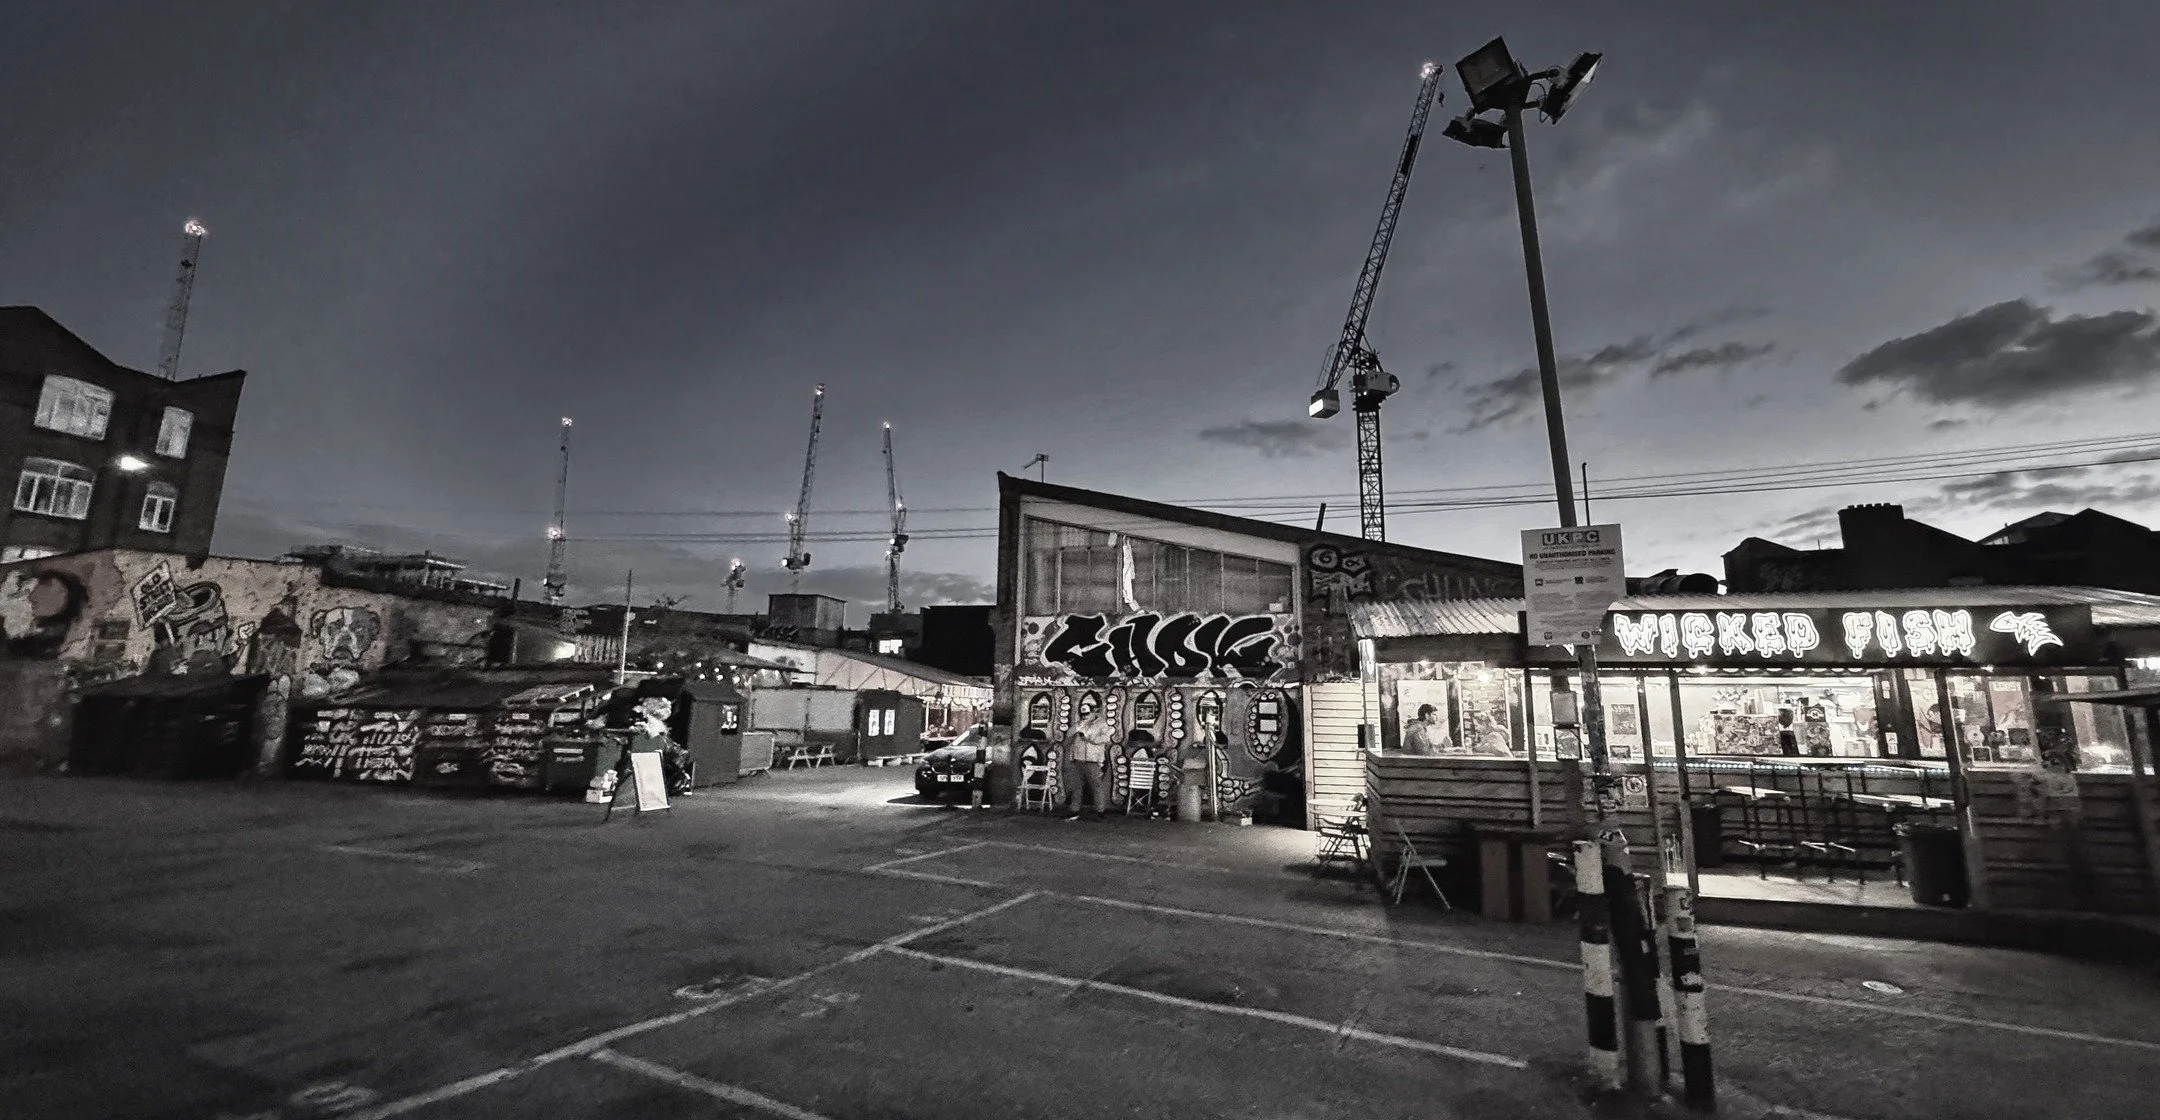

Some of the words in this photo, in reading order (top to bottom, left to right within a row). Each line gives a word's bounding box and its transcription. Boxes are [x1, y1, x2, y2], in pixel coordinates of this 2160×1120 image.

[1543, 531, 1599, 545] UKPC
[1539, 550, 1587, 559] UNAUTHORISED
[1588, 548, 1616, 556] PARKING
[1613, 611, 1820, 659] WICKED
[1842, 609, 1976, 659] FISH
